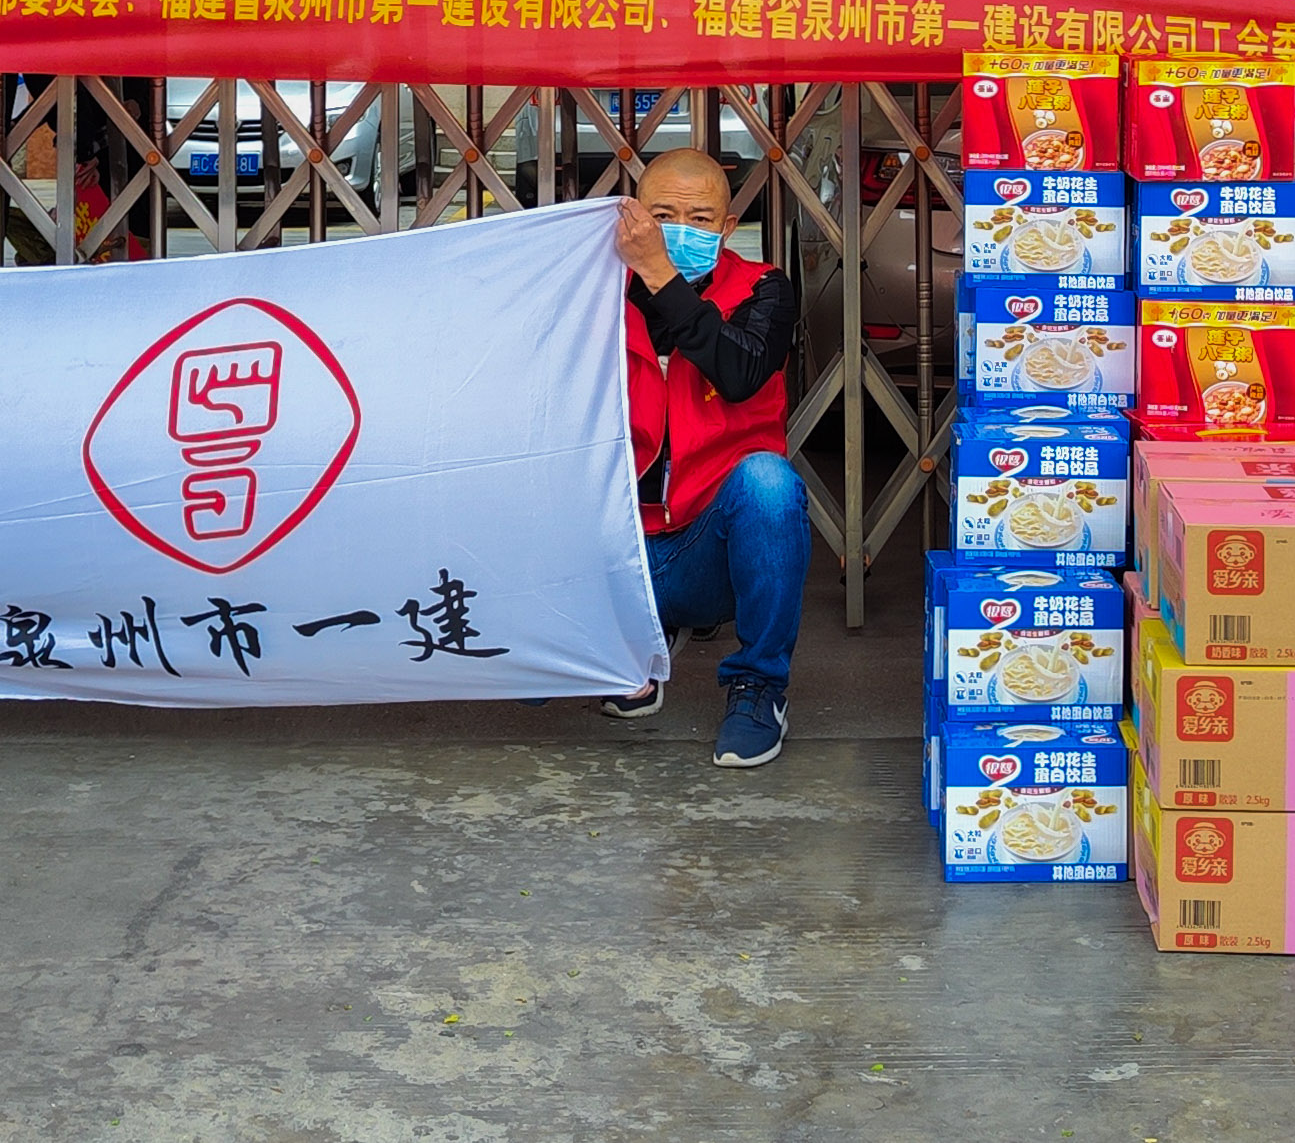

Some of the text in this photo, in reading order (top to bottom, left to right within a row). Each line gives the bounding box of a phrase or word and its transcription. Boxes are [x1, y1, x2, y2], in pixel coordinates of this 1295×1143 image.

[1018, 94, 1072, 111] 八宝粥
[1194, 104, 1248, 120] 八宝粥
[1042, 176, 1098, 190] 牛奶花生
[1042, 190, 1098, 204] 蛋白饮品
[1220, 187, 1276, 201] 牛奶花生
[1220, 201, 1276, 214] 蛋白饮品
[1058, 276, 1115, 289] 其他蛋白饮品
[1054, 295, 1109, 308] 牛奶花生
[1235, 287, 1294, 301] 其他蛋白饮品
[1054, 308, 1109, 322] 蛋白饮品
[1198, 346, 1253, 363] 八宝粥
[1067, 394, 1128, 407] 其他蛋白饮品
[1040, 446, 1099, 461] 牛奶花生
[1040, 461, 1099, 476] 蛋白饮品
[1055, 553, 1116, 567] 其他蛋白饮品
[1213, 570, 1259, 589] 爱乡亲
[1033, 596, 1094, 611] 牛奶花生
[1033, 611, 1094, 627] 蛋白饮品
[1051, 706, 1113, 720] 其他蛋白饮品
[1182, 716, 1228, 735] 爱乡亲
[1034, 751, 1096, 768] 牛奶花生
[1034, 767, 1096, 784] 蛋白饮品
[1246, 794, 1270, 807] 2.5kg
[1052, 865, 1117, 880] 其他蛋白饮品
[1181, 857, 1227, 877] 爱乡亲
